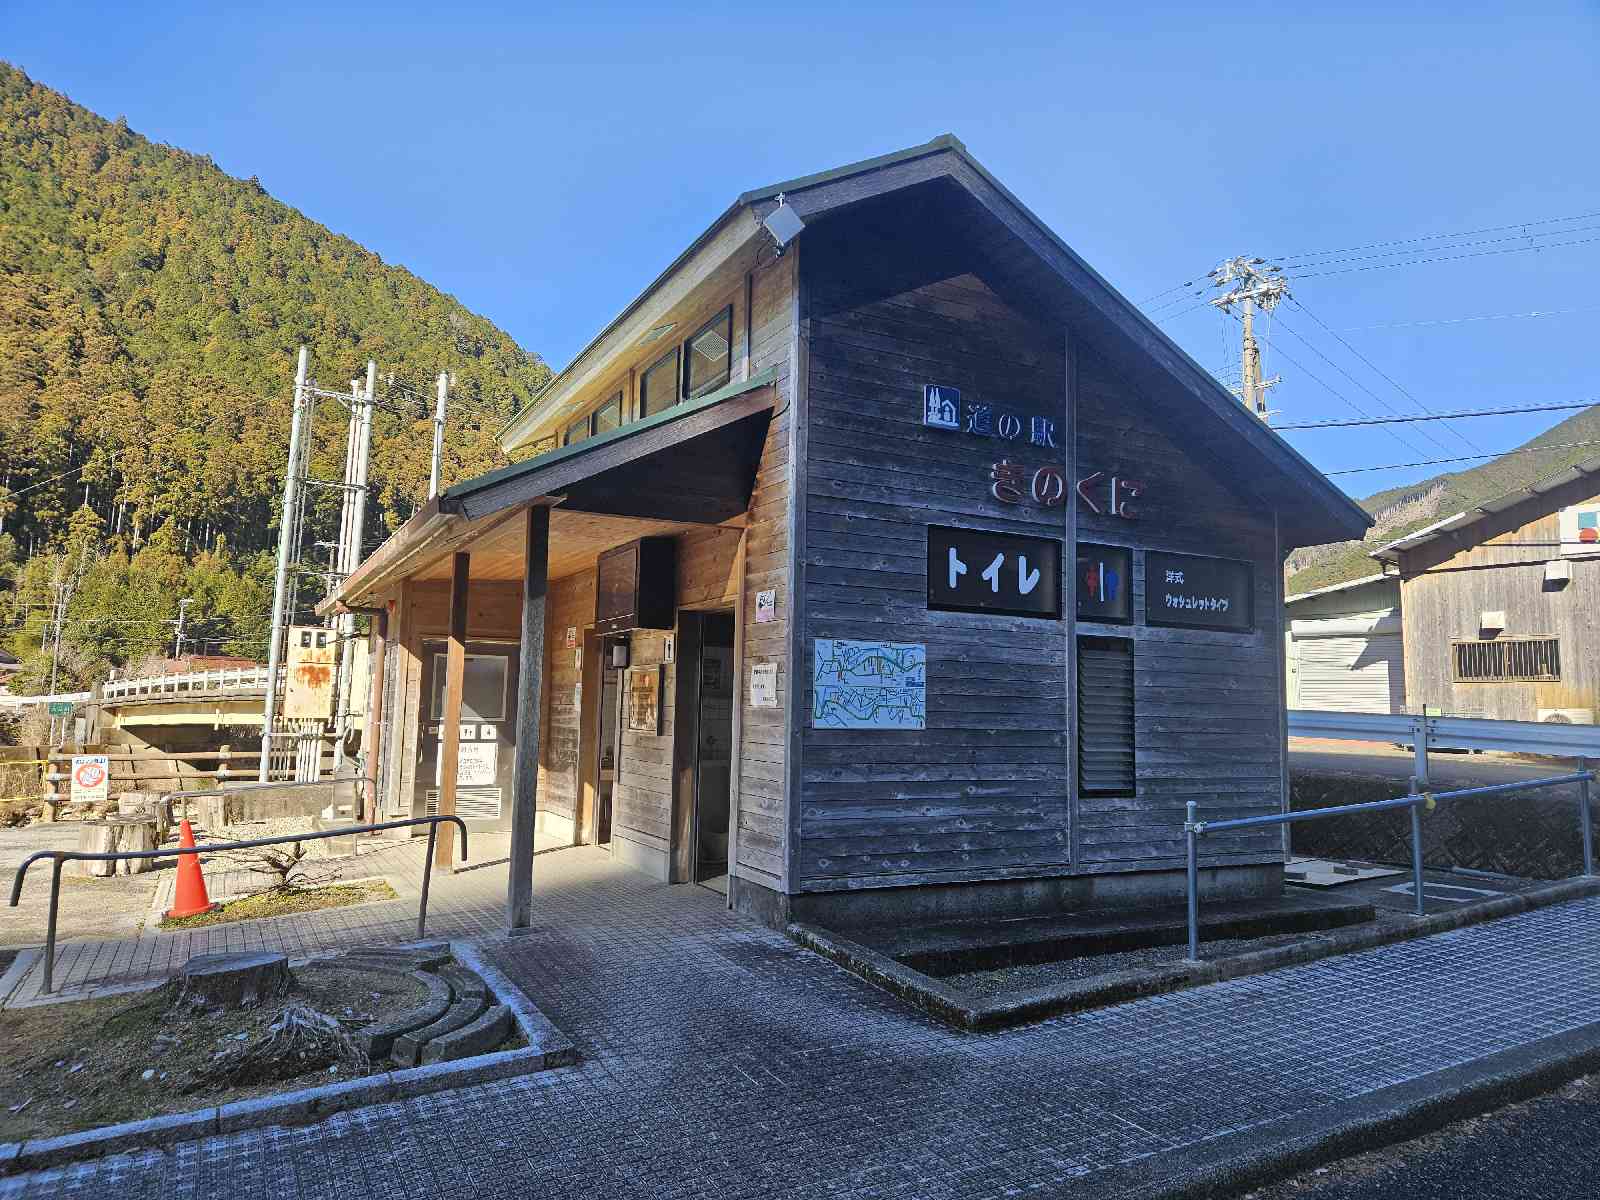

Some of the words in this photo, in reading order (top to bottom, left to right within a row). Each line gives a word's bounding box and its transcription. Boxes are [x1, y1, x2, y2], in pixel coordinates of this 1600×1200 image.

[965, 404, 1057, 449] 道の駅
[990, 459, 1145, 520] きのくに
[947, 545, 1041, 595] トイレ
[1164, 569, 1185, 585] 洋式
